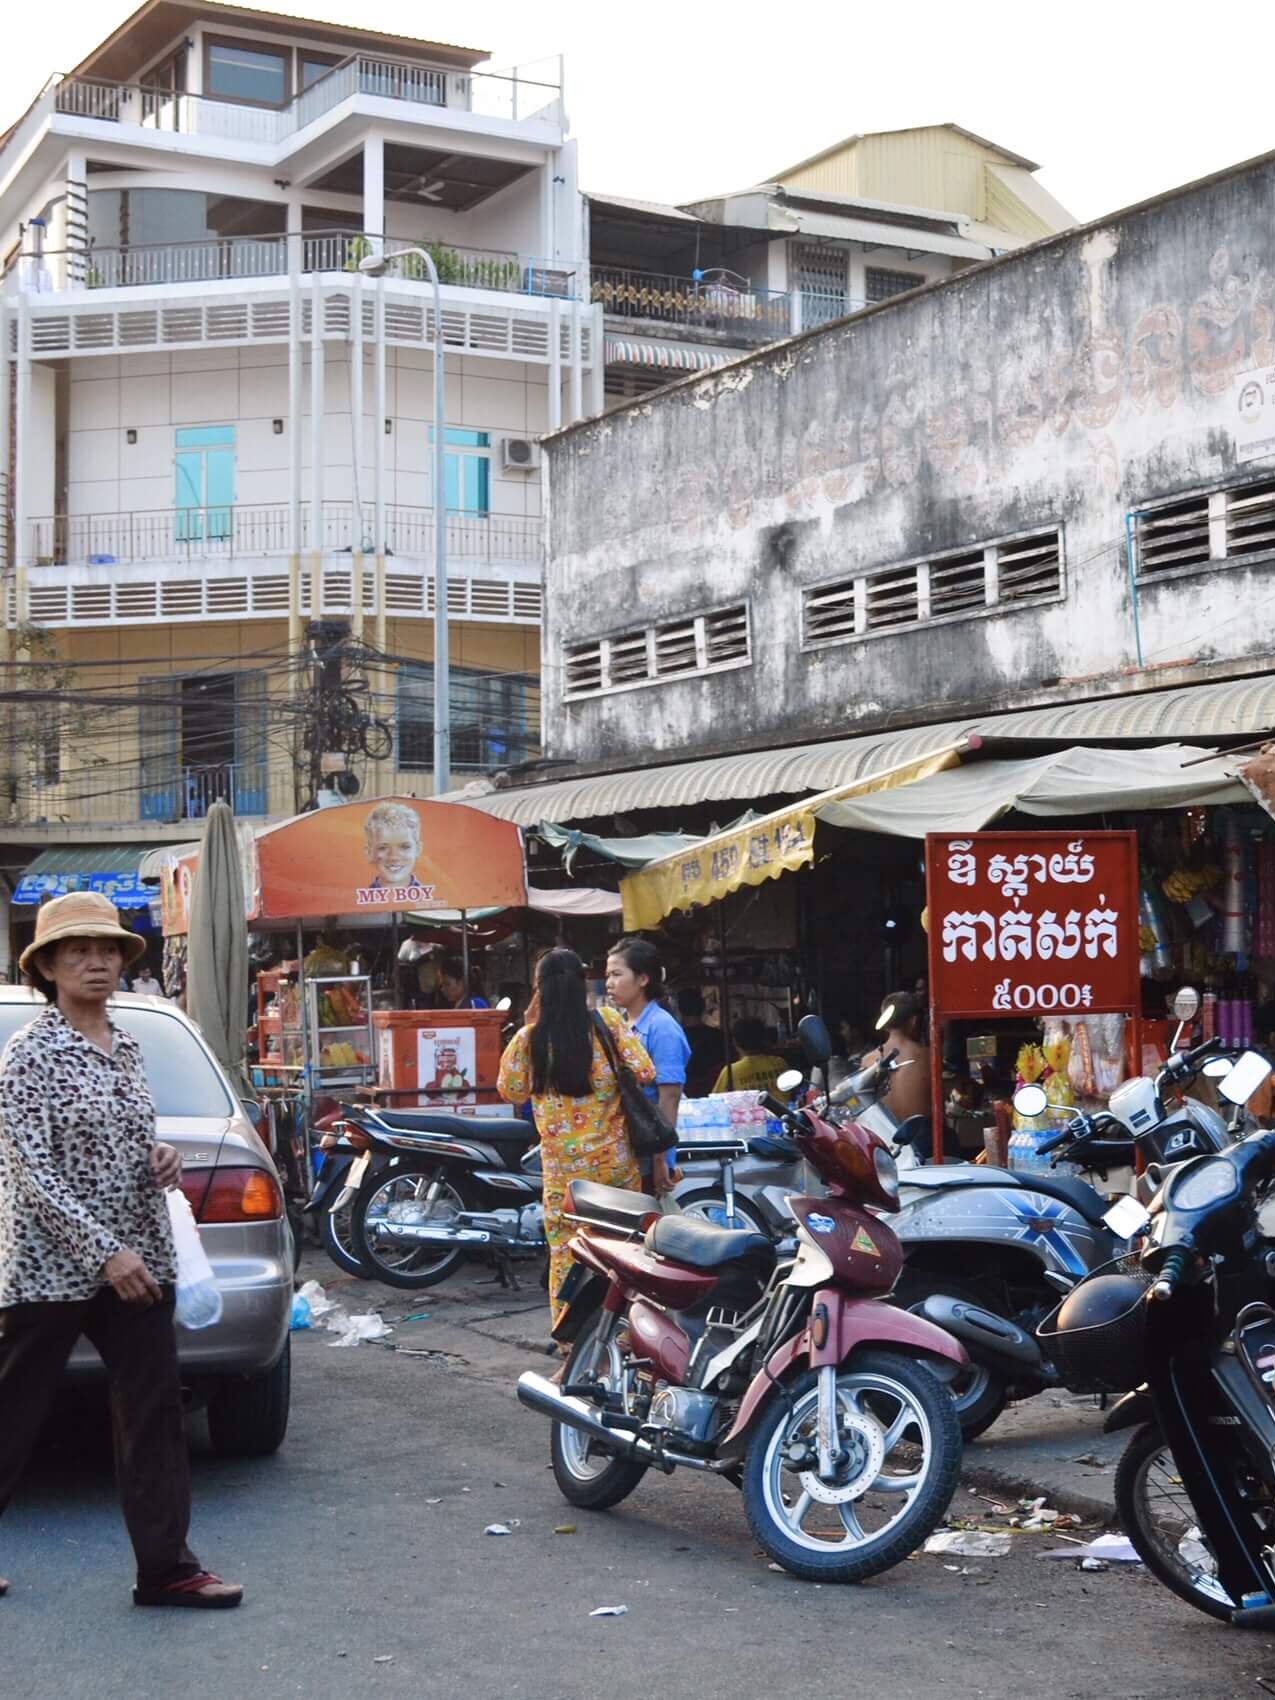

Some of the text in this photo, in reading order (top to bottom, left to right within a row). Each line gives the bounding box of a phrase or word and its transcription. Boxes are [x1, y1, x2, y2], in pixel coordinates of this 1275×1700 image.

[357, 885, 435, 904] MY BOY
[941, 893, 1119, 962] កាត់សក់
[1207, 1415, 1242, 1425] ONDA
